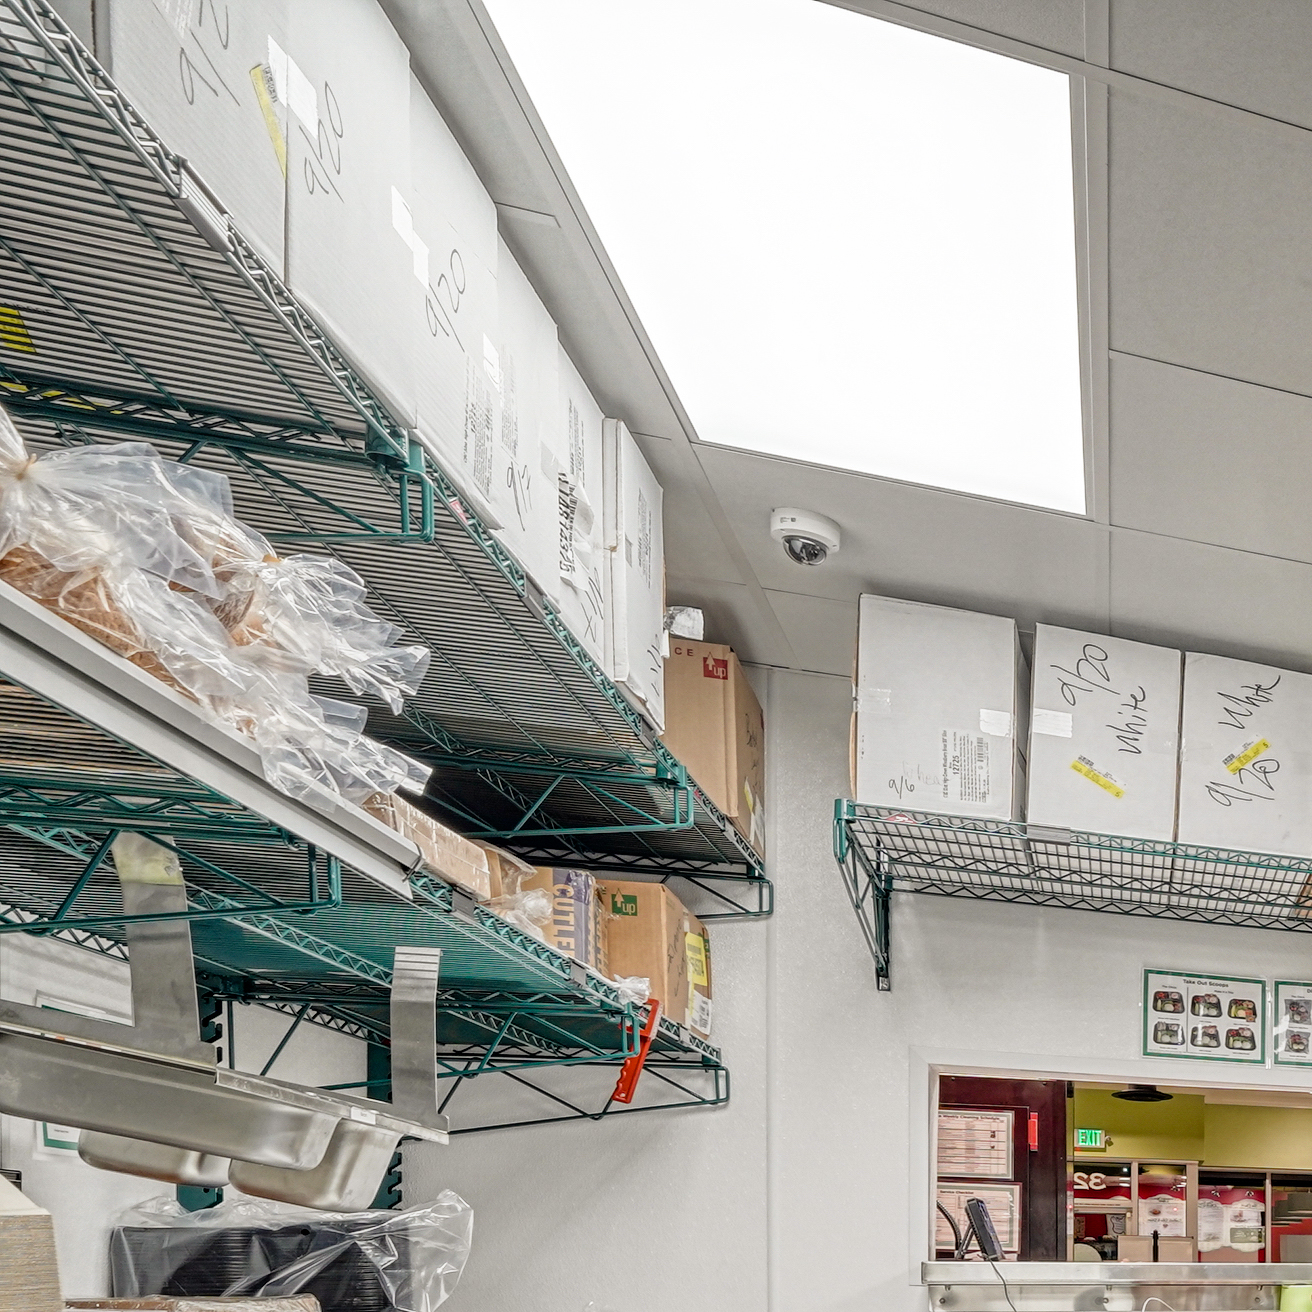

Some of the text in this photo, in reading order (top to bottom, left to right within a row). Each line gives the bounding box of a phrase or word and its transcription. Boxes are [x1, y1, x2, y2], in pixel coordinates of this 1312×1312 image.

[425, 248, 465, 353] 9/20
[714, 666, 726, 680] up
[1050, 644, 1121, 706] 9/20
[952, 755, 960, 776] 12725
[1205, 758, 1280, 807] 9/20
[622, 902, 636, 916] up
[1183, 978, 1198, 986] Take
[1078, 1129, 1102, 1146] EXIT
